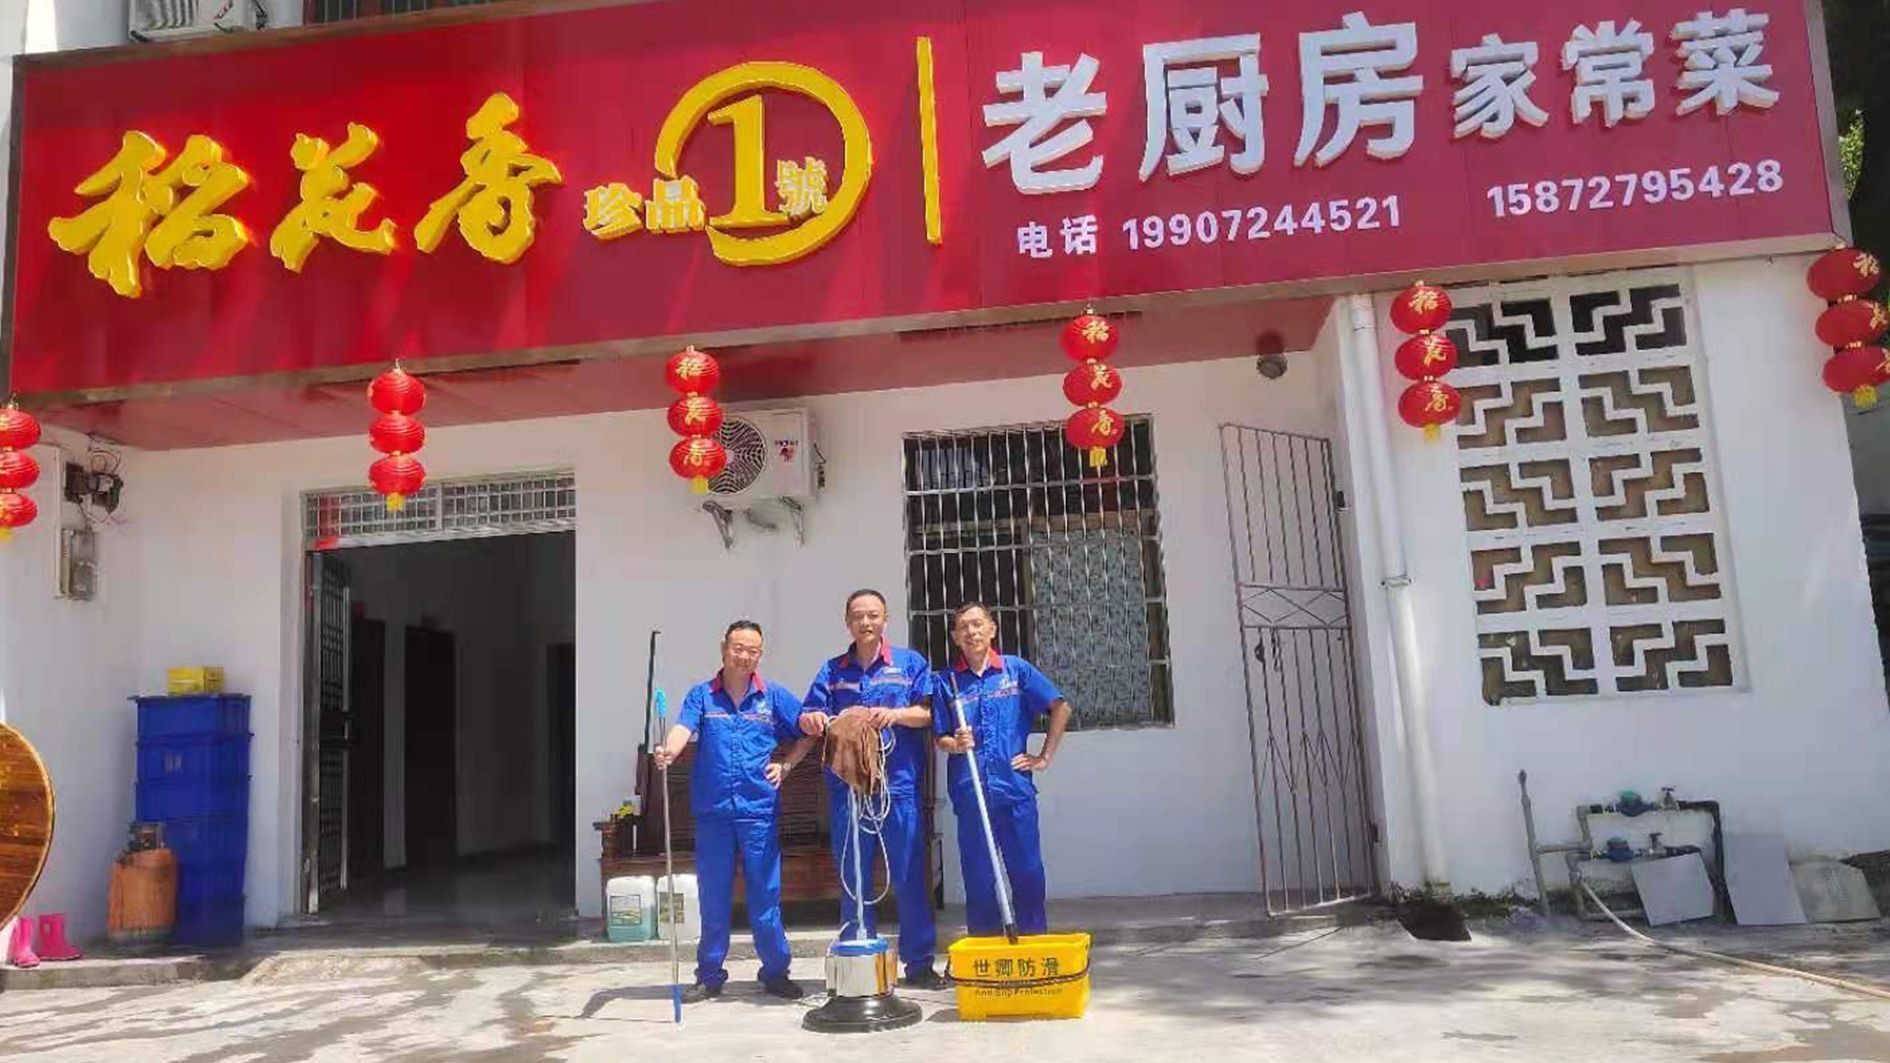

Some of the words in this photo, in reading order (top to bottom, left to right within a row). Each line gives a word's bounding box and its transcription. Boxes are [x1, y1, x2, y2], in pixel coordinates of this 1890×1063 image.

[982, 11, 1424, 194] 老厨房
[1452, 8, 1780, 138] 家常菜
[48, 91, 563, 298] 稻花香
[1017, 215, 1098, 258] 电话
[1122, 195, 1400, 250] 19907244521
[1487, 159, 1783, 217] 15872795428
